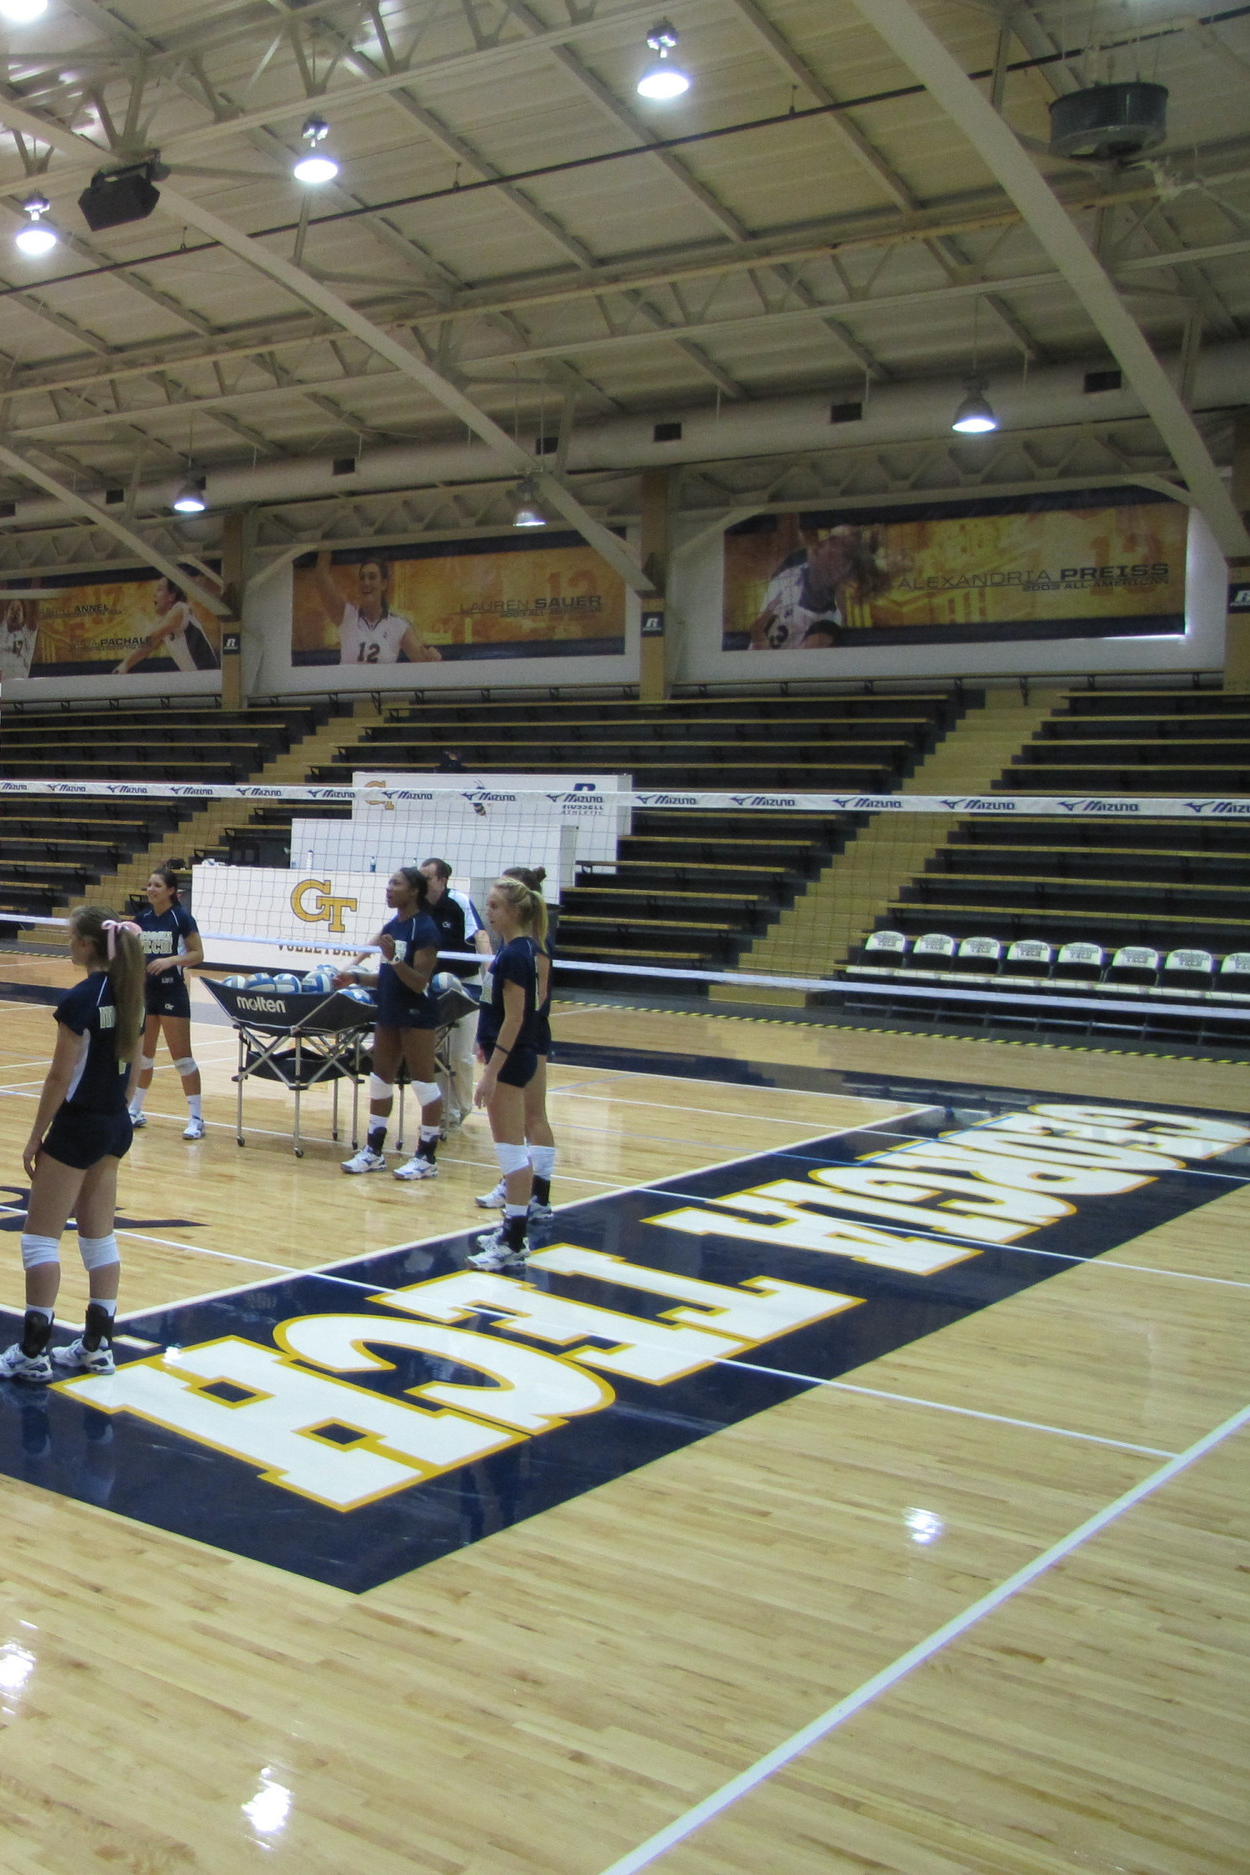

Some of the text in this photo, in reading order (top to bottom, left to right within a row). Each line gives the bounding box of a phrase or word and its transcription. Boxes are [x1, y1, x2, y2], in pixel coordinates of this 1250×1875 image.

[900, 563, 1170, 590] ALEXANDRIA PREISS
[460, 595, 602, 614] LAUREN SAUER
[357, 641, 381, 664] 12
[290, 878, 357, 933] GT
[236, 995, 286, 1014] molten
[639, 1103, 1250, 1276] GEORGIA
[49, 1242, 867, 1512] TECH
